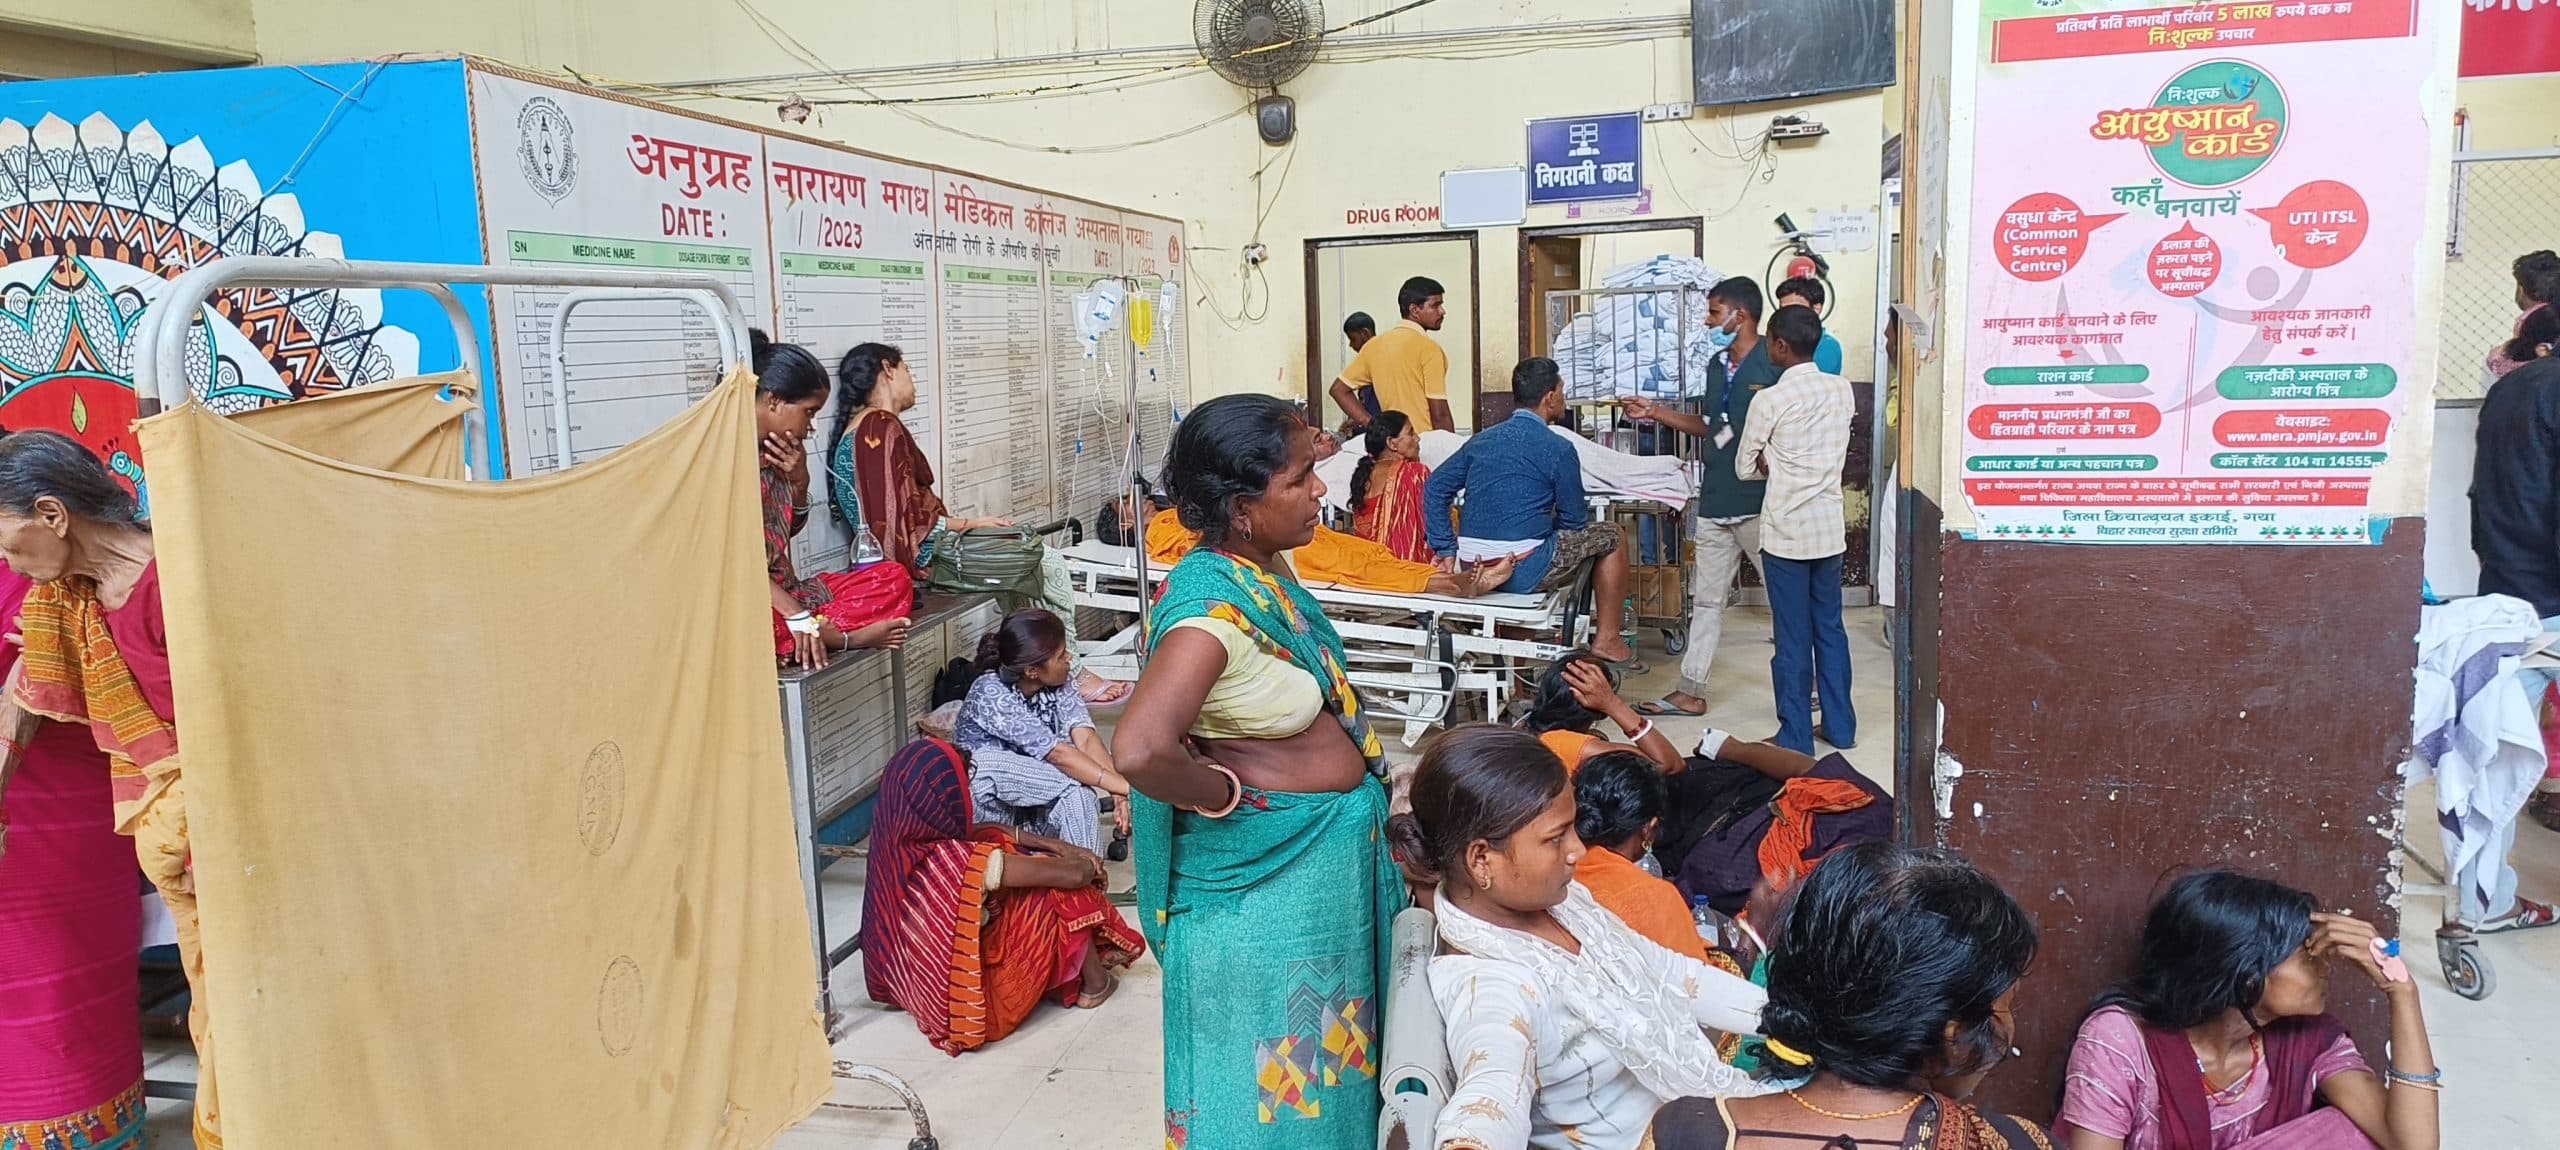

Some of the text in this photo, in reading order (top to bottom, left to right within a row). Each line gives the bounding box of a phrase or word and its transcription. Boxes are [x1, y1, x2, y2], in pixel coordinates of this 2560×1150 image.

[2055, 20, 2096, 33] प्रतिवर्ष
[2099, 15, 2123, 29] प्रति
[2126, 11, 2171, 28] लाभार्थी
[2174, 9, 2213, 23] परिवार
[2216, 7, 2228, 22] 5
[2233, 4, 2272, 21] लाख
[2309, 4, 2331, 16] तक
[2334, 2, 2353, 14] का
[2148, 27, 2255, 48] निःशुल्क उपचार
[2167, 85, 2221, 104] निःशुल्क
[2093, 102, 2256, 142] आयुष्मान
[2187, 123, 2279, 158] कार्ड
[1535, 159, 1635, 188] निगरानी कक्ष
[627, 134, 752, 199] अनुग्रह
[771, 160, 866, 208] नारायण
[881, 180, 929, 217] मगध
[943, 181, 1014, 231] मेडिकल
[1024, 201, 1067, 237] कॉलेज
[1075, 216, 1120, 245] अस्पताल
[2112, 179, 2163, 206] कहाँ
[2154, 190, 2242, 219] बनवायें
[1347, 206, 1439, 224] DRUG ROOM
[2006, 207, 2079, 229] वसुधा केन्द्र
[2288, 209, 2357, 226] UTI ITSL
[2003, 228, 2078, 243] (Common
[2194, 236, 2210, 249] की
[2304, 229, 2338, 246] केन्द्र
[514, 240, 527, 253] SN
[572, 244, 611, 258] MEDICINE
[613, 248, 636, 260] NAME
[963, 233, 981, 256] रोगी
[986, 236, 995, 257] के
[1001, 238, 1027, 260] औषधि
[1031, 242, 1041, 262] की
[1044, 244, 1061, 268] सूची
[2012, 244, 2067, 257] Service
[2010, 259, 2067, 273] Centre)
[2155, 268, 2169, 279] पर
[2160, 281, 2205, 292] अस्पताल
[2251, 305, 2371, 321] आवश्यक जानकारी
[1983, 311, 2158, 333] आयुष्मान कार्ड बनवाने के लिए
[2012, 334, 2068, 346] आवश्यक
[2262, 327, 2282, 343] हेतु
[2286, 324, 2321, 340] संपर्क
[2325, 323, 2348, 338] करें
[2036, 367, 2095, 383] राशन कार्ड
[2298, 369, 2351, 381] अस्पताल
[2354, 366, 2369, 381] के
[2270, 382, 2341, 397] आरोग्य मित्र
[1997, 407, 2130, 422] माननीय प्रधानमंत्री जी का
[1990, 422, 2137, 437] हितग्राही परिवार के नाम पत्र
[2226, 430, 2378, 444] www.mera.pmjay.gov.in
[1978, 456, 2146, 470] आधार कार्ड या अन्य पहचान पत्र
[2219, 456, 2248, 467] कॉल
[2284, 457, 2309, 467] 104
[2311, 457, 2326, 467] या
[2328, 456, 2373, 467] 14555
[2063, 509, 2101, 521] जिला
[2243, 512, 2275, 522] गया
[2097, 525, 2125, 536] बिहार
[2201, 525, 2237, 535] समिति
